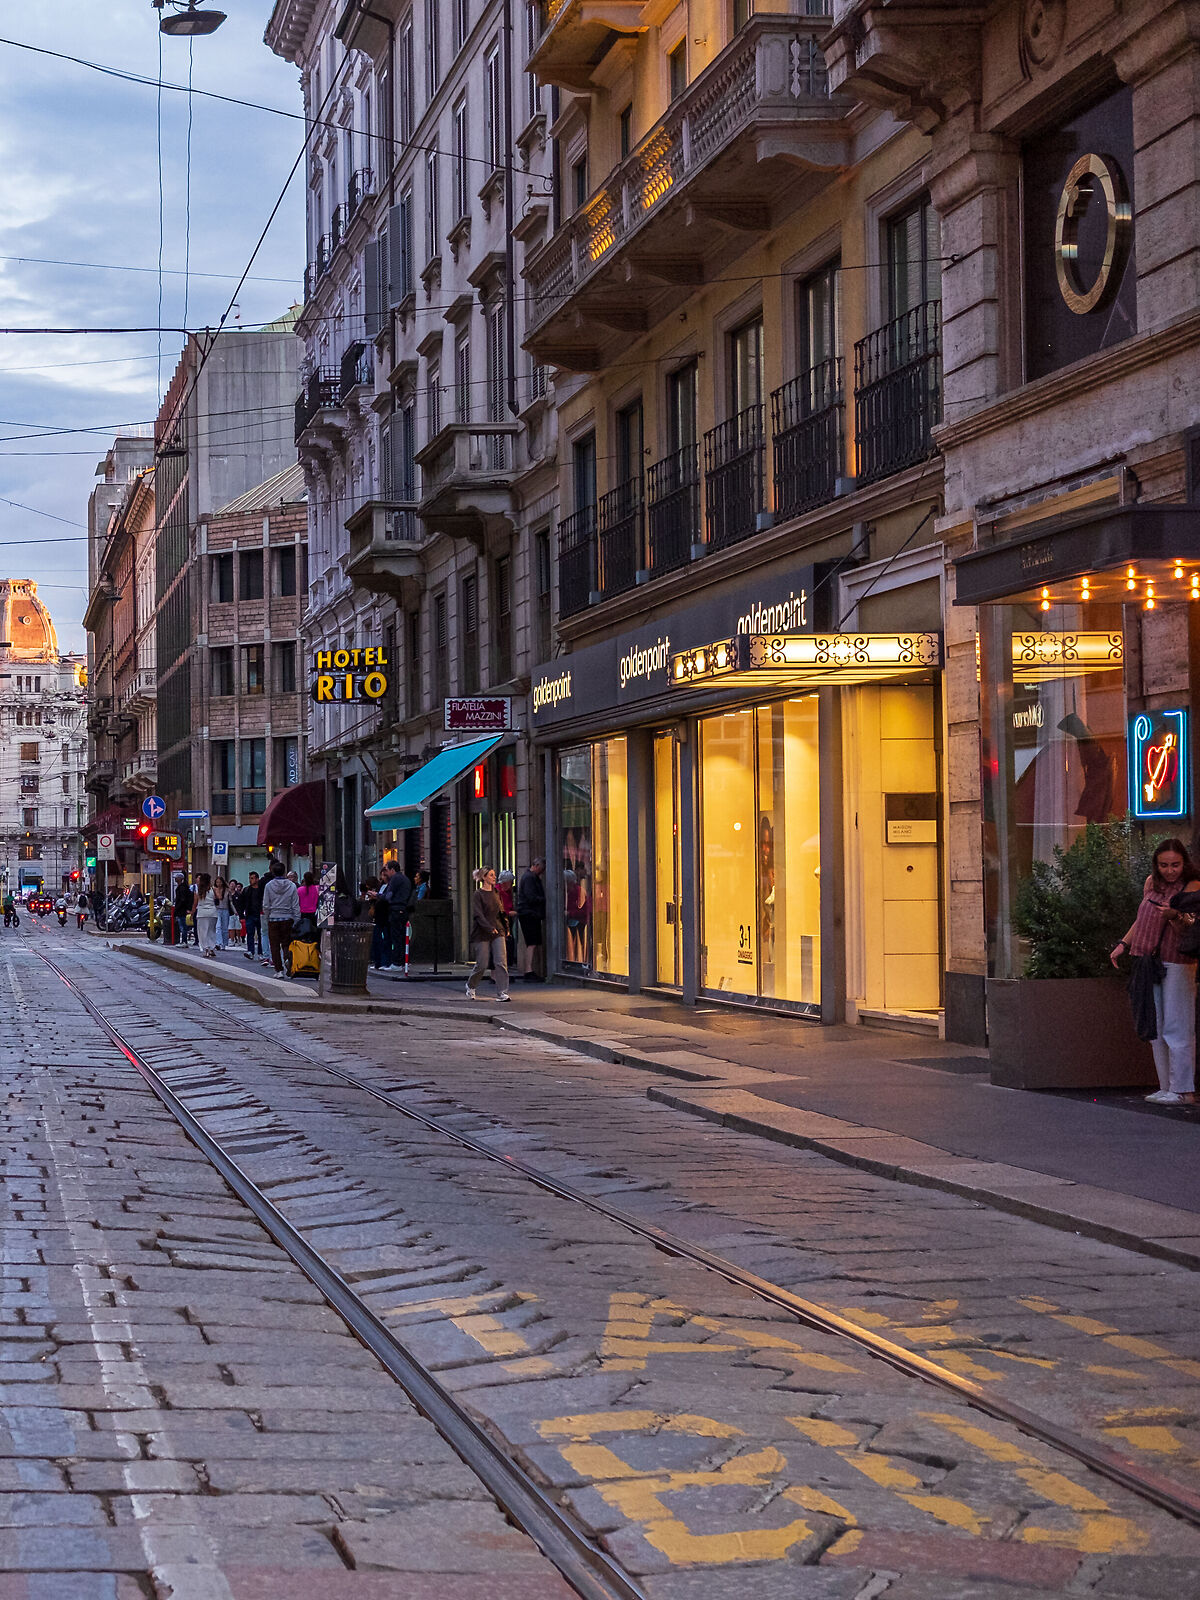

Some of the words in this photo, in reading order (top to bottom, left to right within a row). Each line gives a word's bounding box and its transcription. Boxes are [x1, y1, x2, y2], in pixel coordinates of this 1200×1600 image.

[317, 646, 388, 669] HOTEL
[619, 636, 671, 689] goldenpoint
[317, 671, 388, 701] RIO
[532, 670, 572, 713] goldenpoint
[451, 702, 486, 711] FILATELIA
[465, 711, 502, 720] MAZZINI
[216, 844, 224, 853] P
